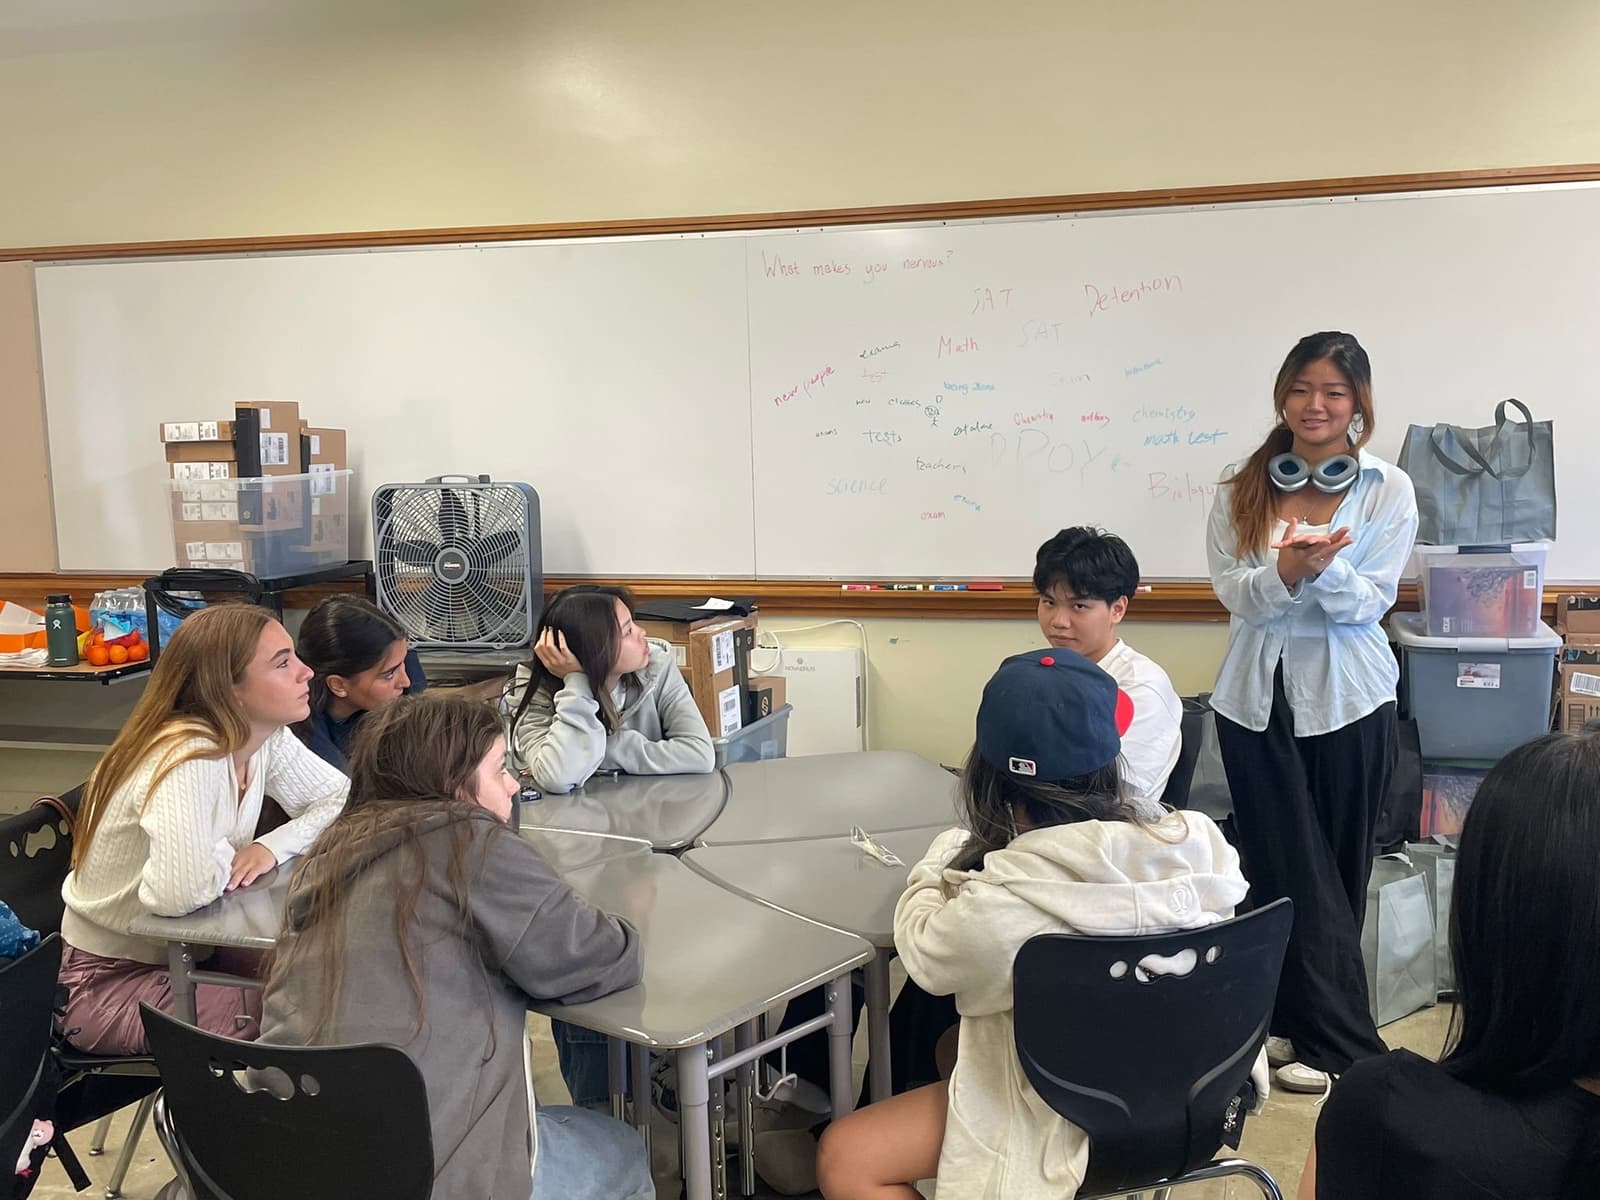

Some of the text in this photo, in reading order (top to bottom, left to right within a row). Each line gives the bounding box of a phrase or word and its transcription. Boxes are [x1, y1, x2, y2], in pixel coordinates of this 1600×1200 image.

[760, 249, 954, 285] What makes you nervous?
[971, 287, 1013, 315] SAT
[1084, 275, 1182, 319] Detention
[938, 335, 979, 359] Math
[1015, 319, 1064, 348] SAT
[774, 366, 836, 407] new people
[1131, 403, 1197, 424] chemistry
[826, 478, 889, 497] science
[920, 511, 948, 520] exam
